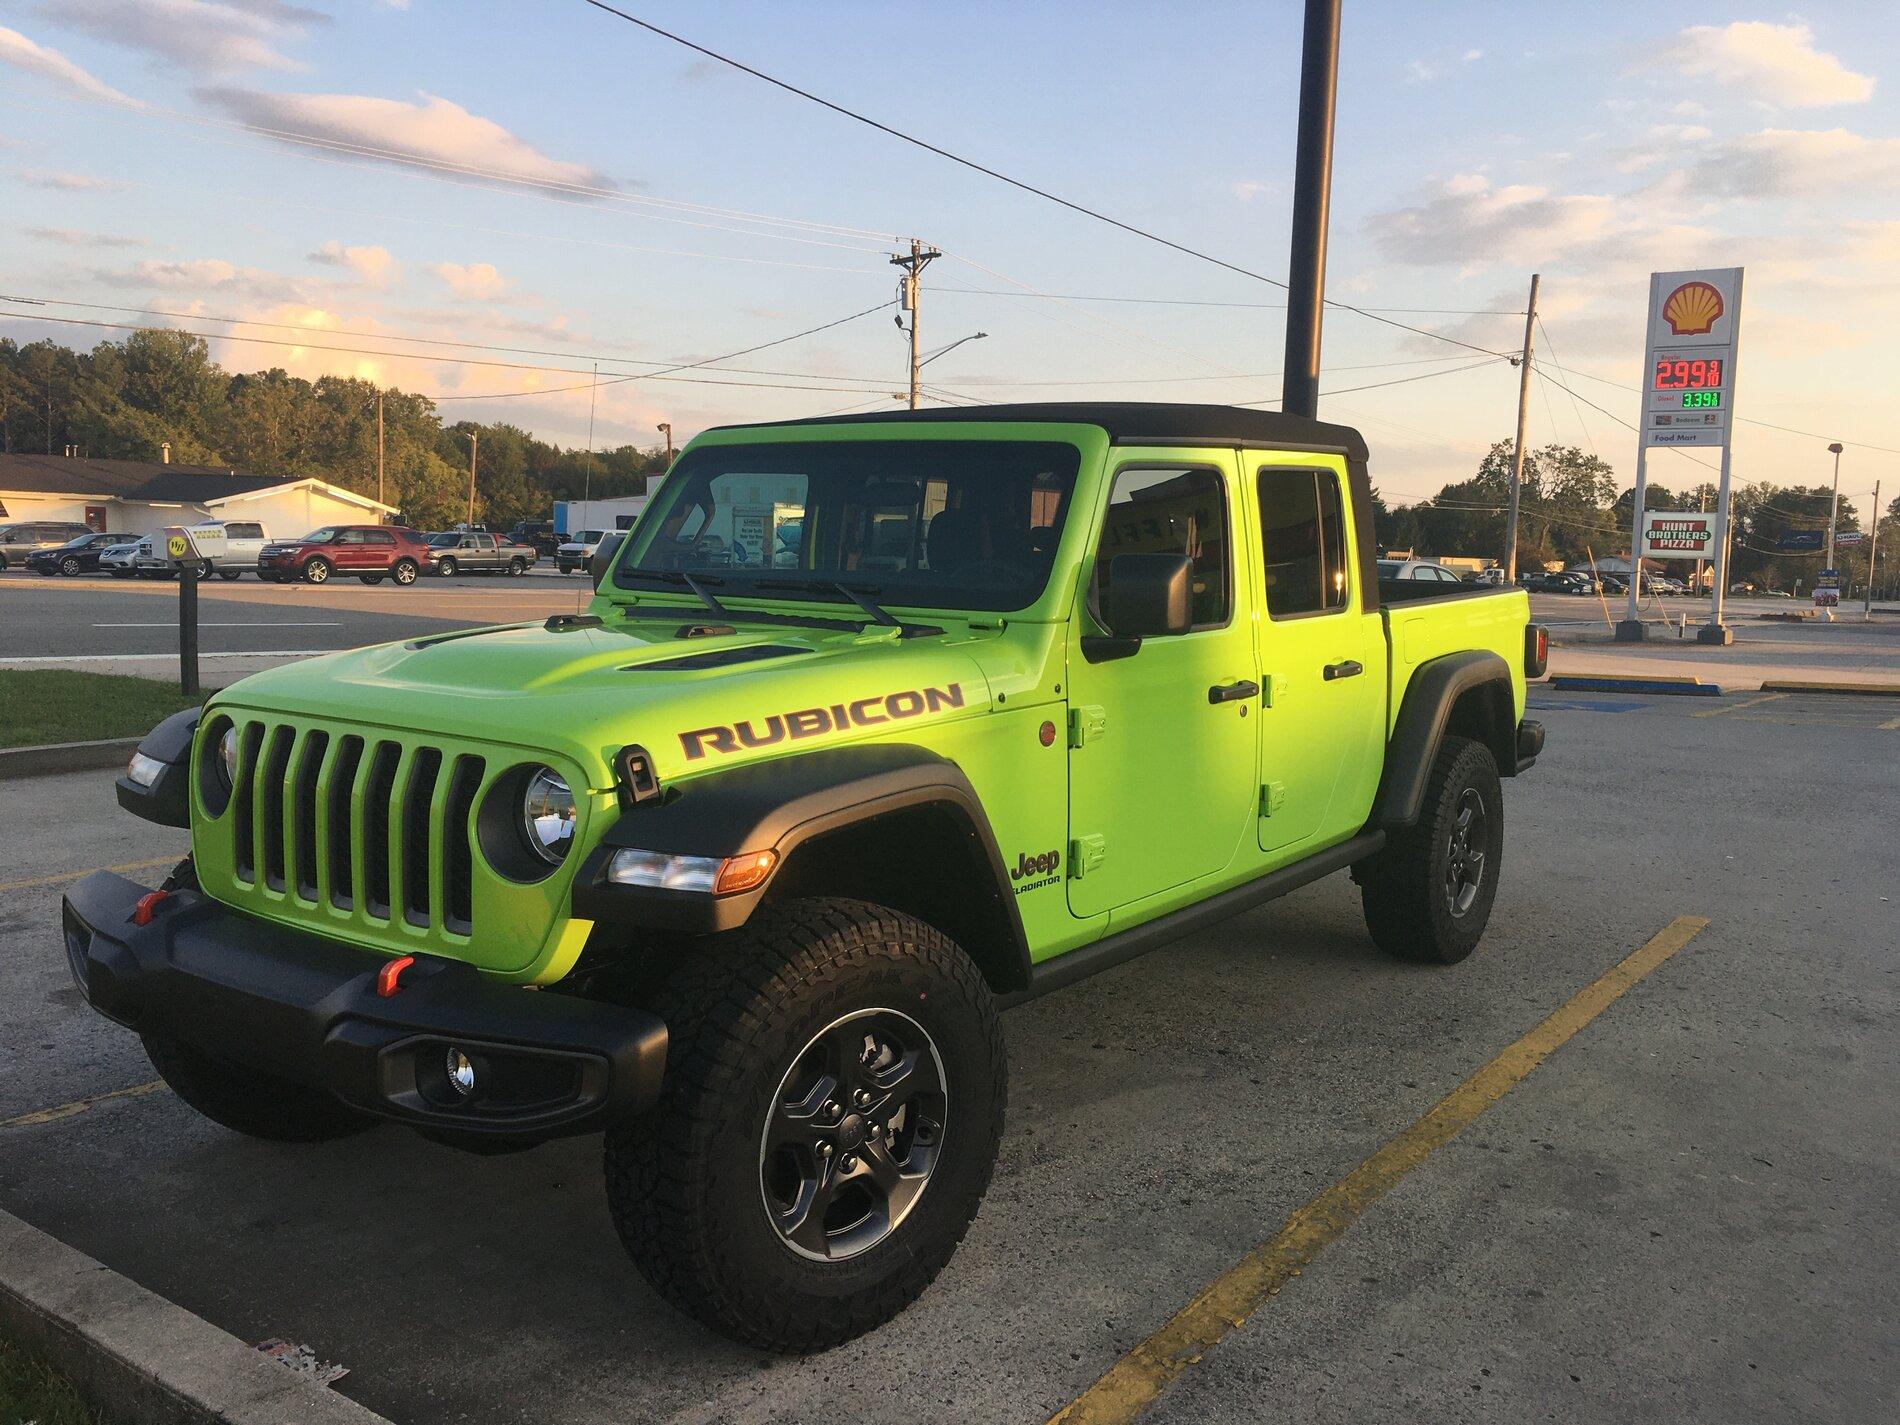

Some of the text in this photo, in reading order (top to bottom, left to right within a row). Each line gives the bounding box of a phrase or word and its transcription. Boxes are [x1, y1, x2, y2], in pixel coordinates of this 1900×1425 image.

[1654, 434, 1675, 442] Food
[1661, 522, 1696, 531] HUNT
[1648, 530, 1708, 540] BROTHERS
[1660, 540, 1695, 549] PIZZA
[677, 682, 965, 761] RUBICON
[1010, 850, 1060, 880] Jeep
